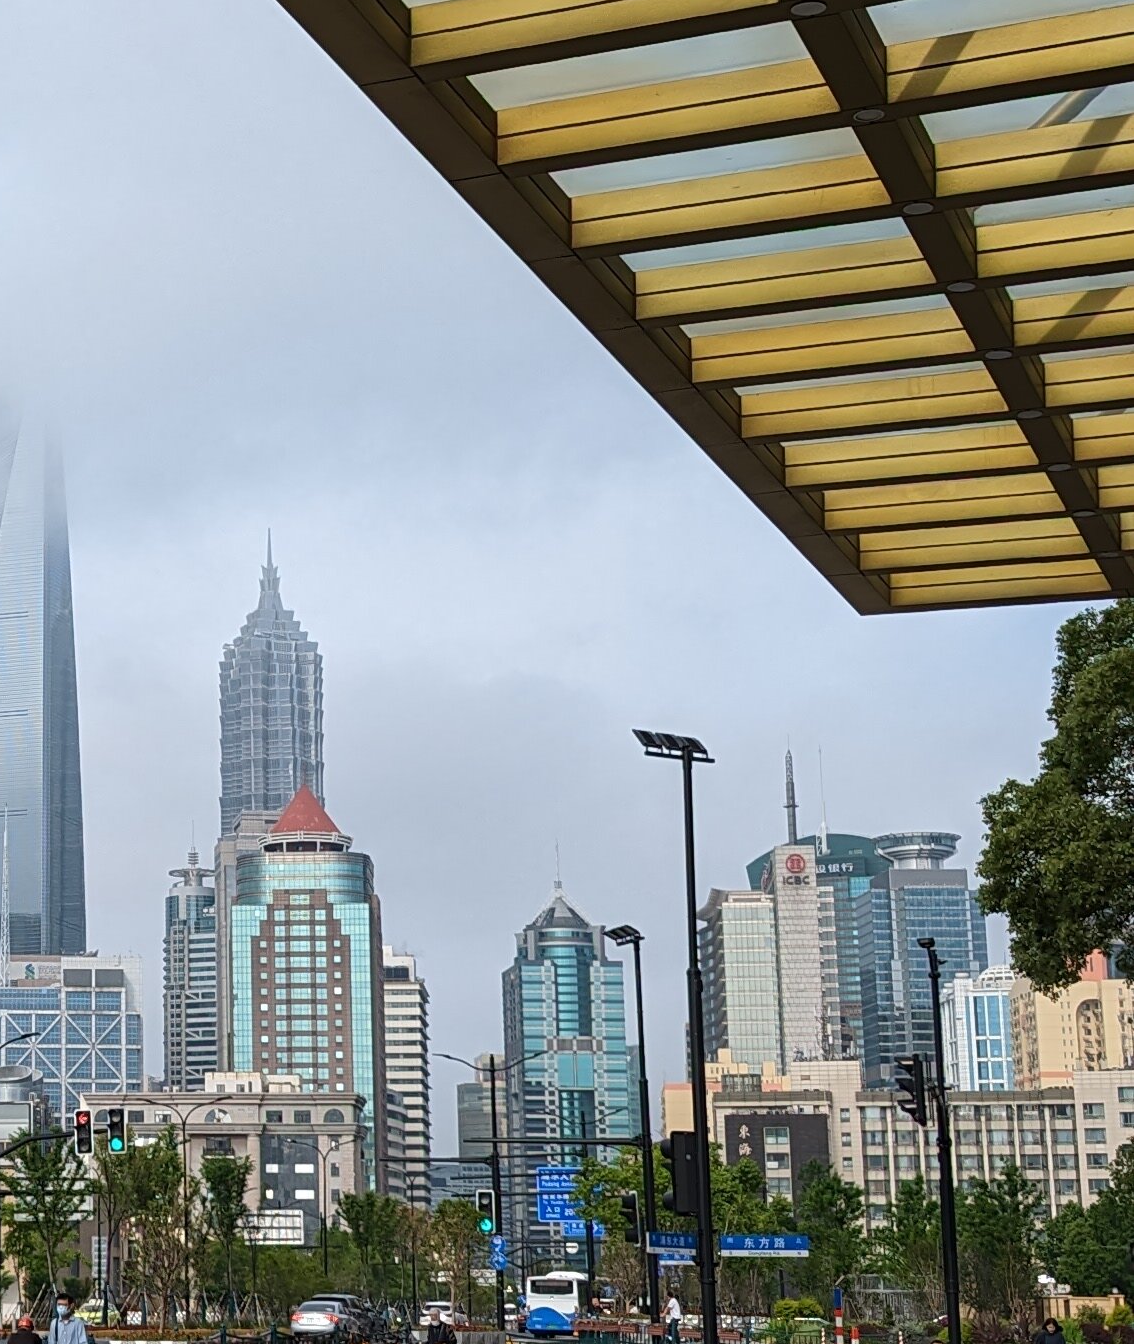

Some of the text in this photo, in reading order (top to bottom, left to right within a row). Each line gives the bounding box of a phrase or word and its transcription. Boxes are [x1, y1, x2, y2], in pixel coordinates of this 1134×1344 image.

[782, 875, 810, 886] ICBC
[743, 1237, 785, 1249] 东方路
